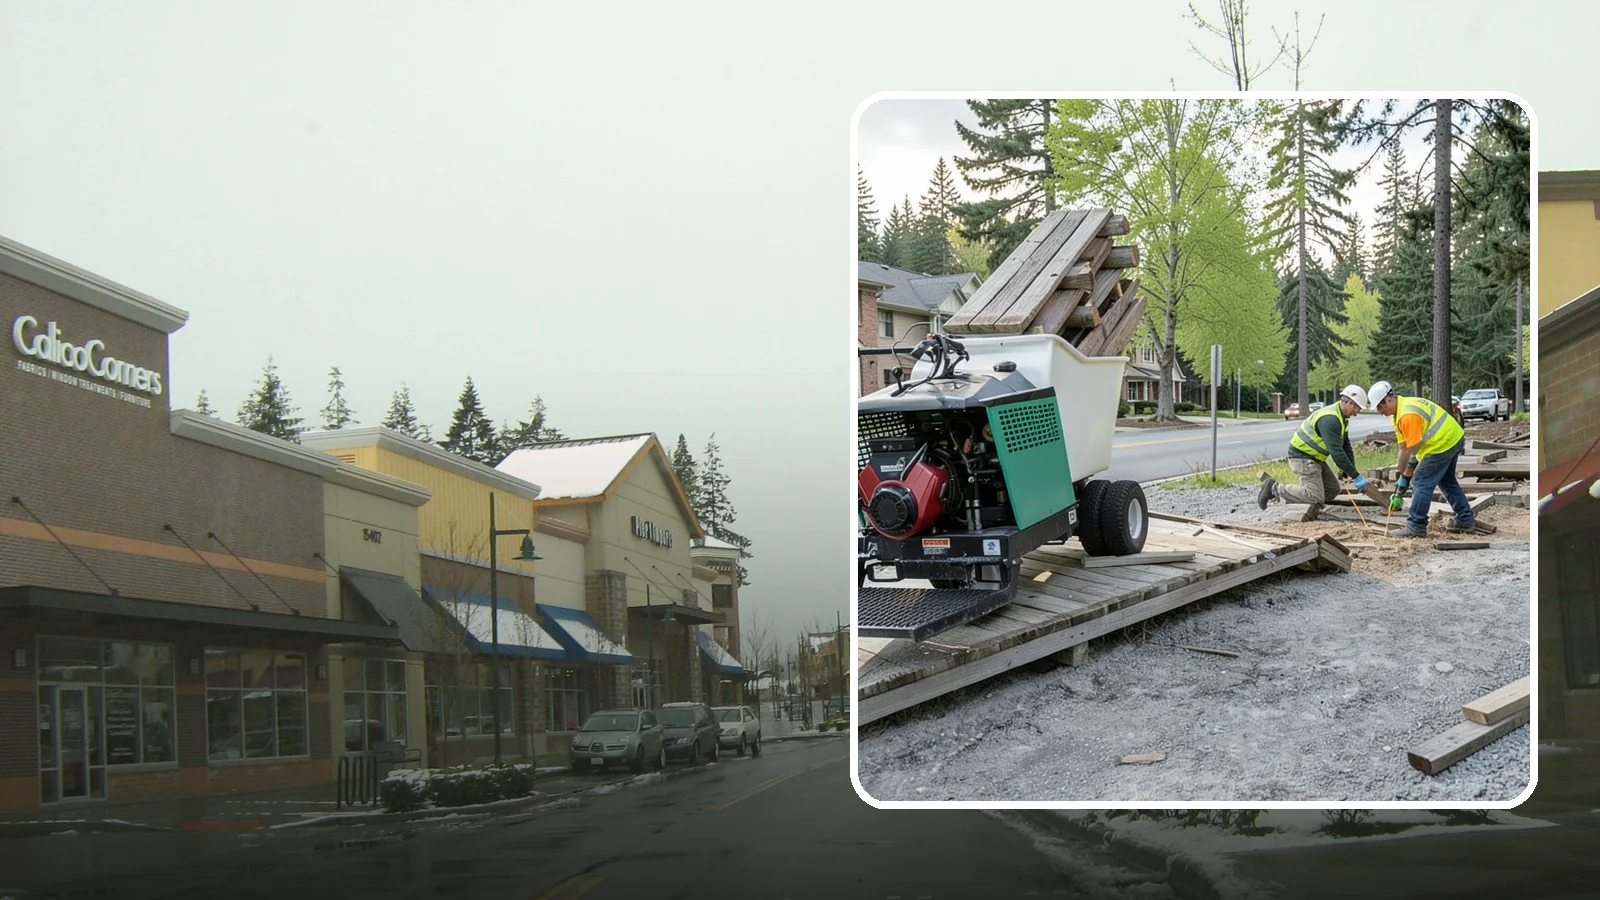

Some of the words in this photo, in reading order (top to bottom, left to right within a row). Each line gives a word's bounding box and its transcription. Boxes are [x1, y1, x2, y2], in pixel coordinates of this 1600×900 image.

[17, 360, 47, 378] FABRICS
[51, 369, 78, 387] WINDOW
[79, 378, 117, 399] TREATMENTS
[120, 391, 151, 409] FURNITURE
